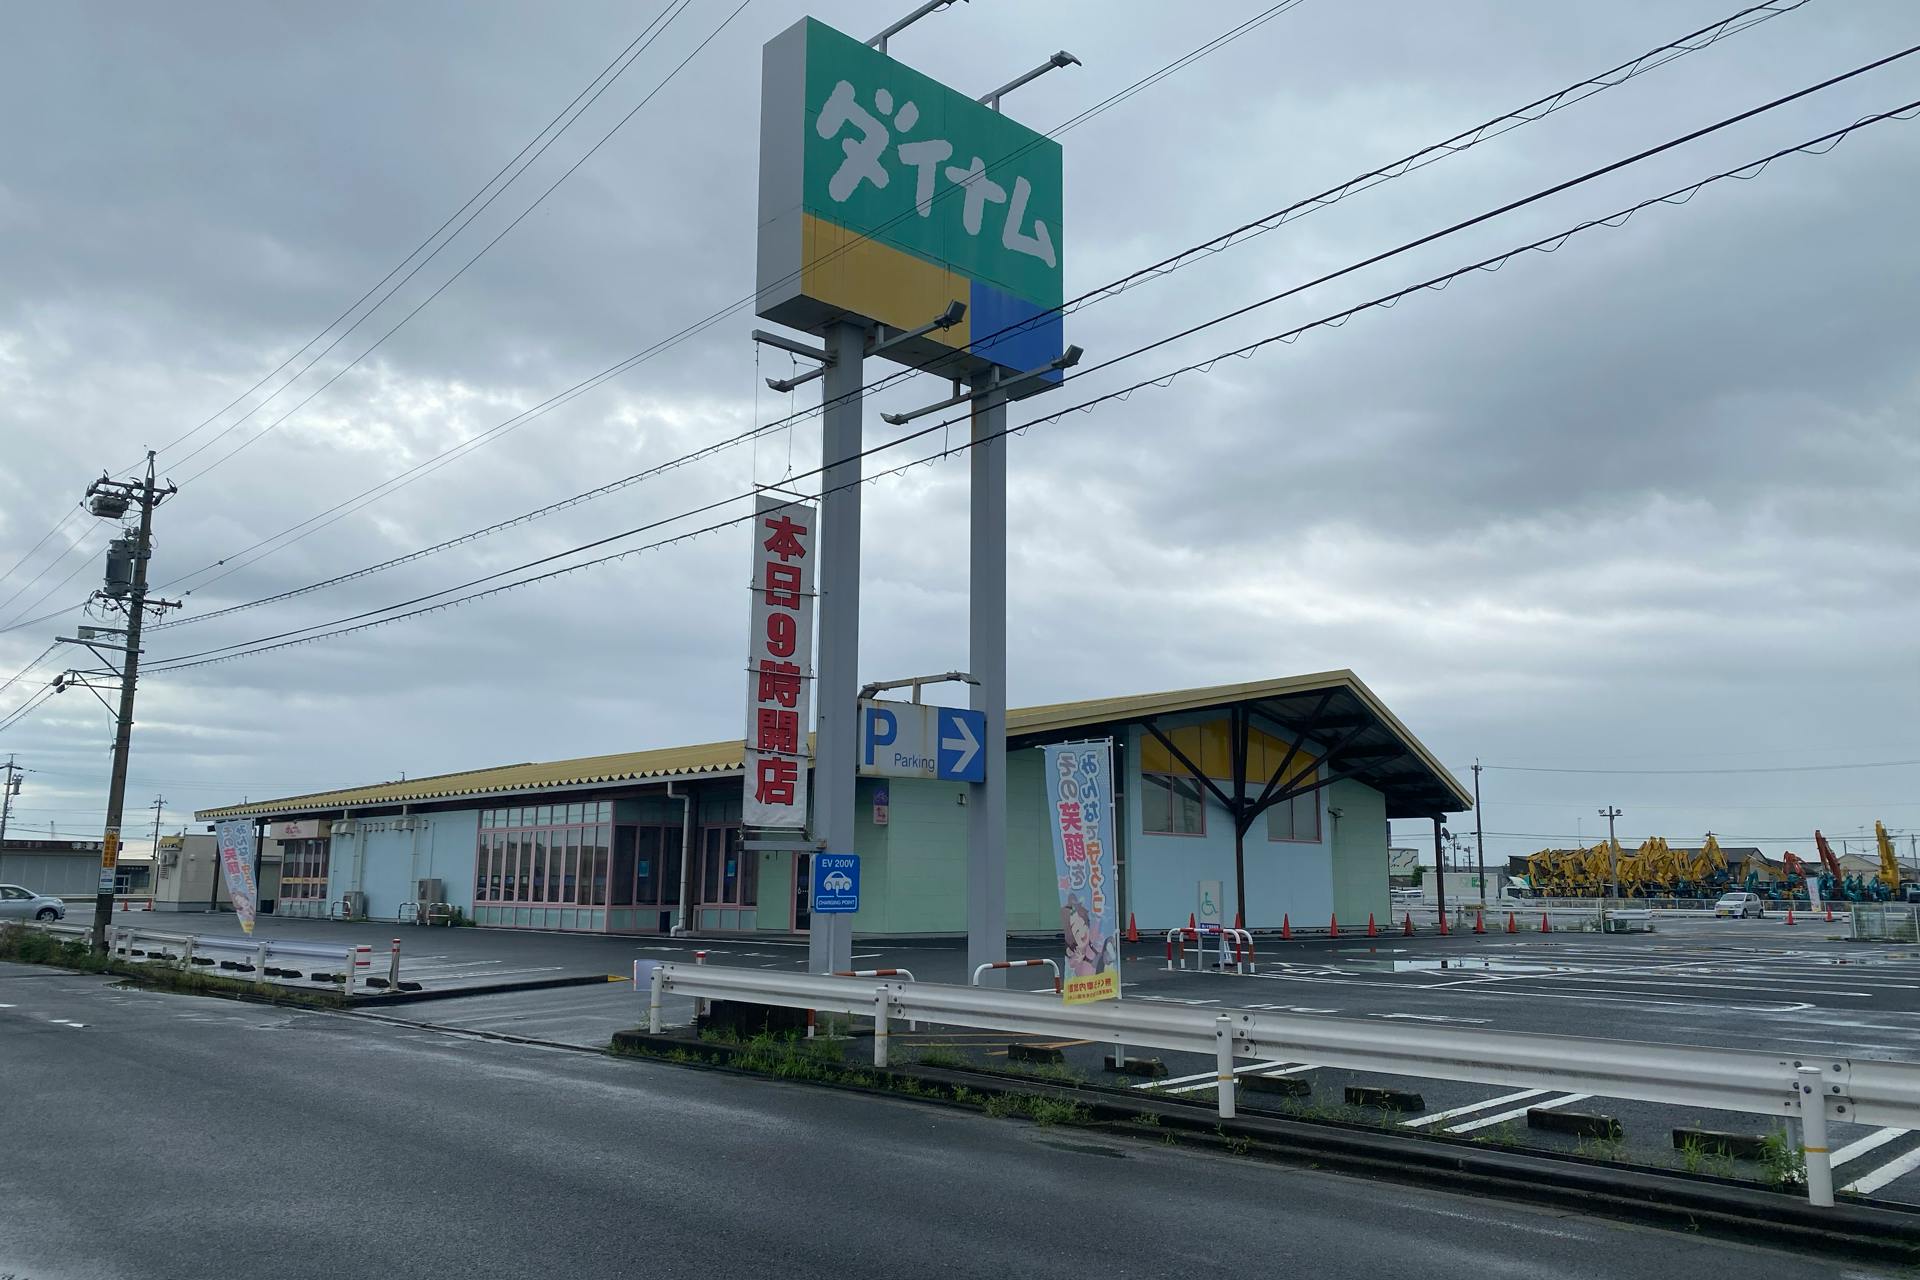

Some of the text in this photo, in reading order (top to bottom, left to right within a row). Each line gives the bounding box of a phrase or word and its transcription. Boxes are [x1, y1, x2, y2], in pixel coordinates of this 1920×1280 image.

[816, 79, 1056, 268] ダイナム
[756, 515, 807, 806] 本日9時開店
[865, 707, 898, 765] P
[894, 752, 935, 772] Parking
[822, 859, 854, 868] EV 200V
